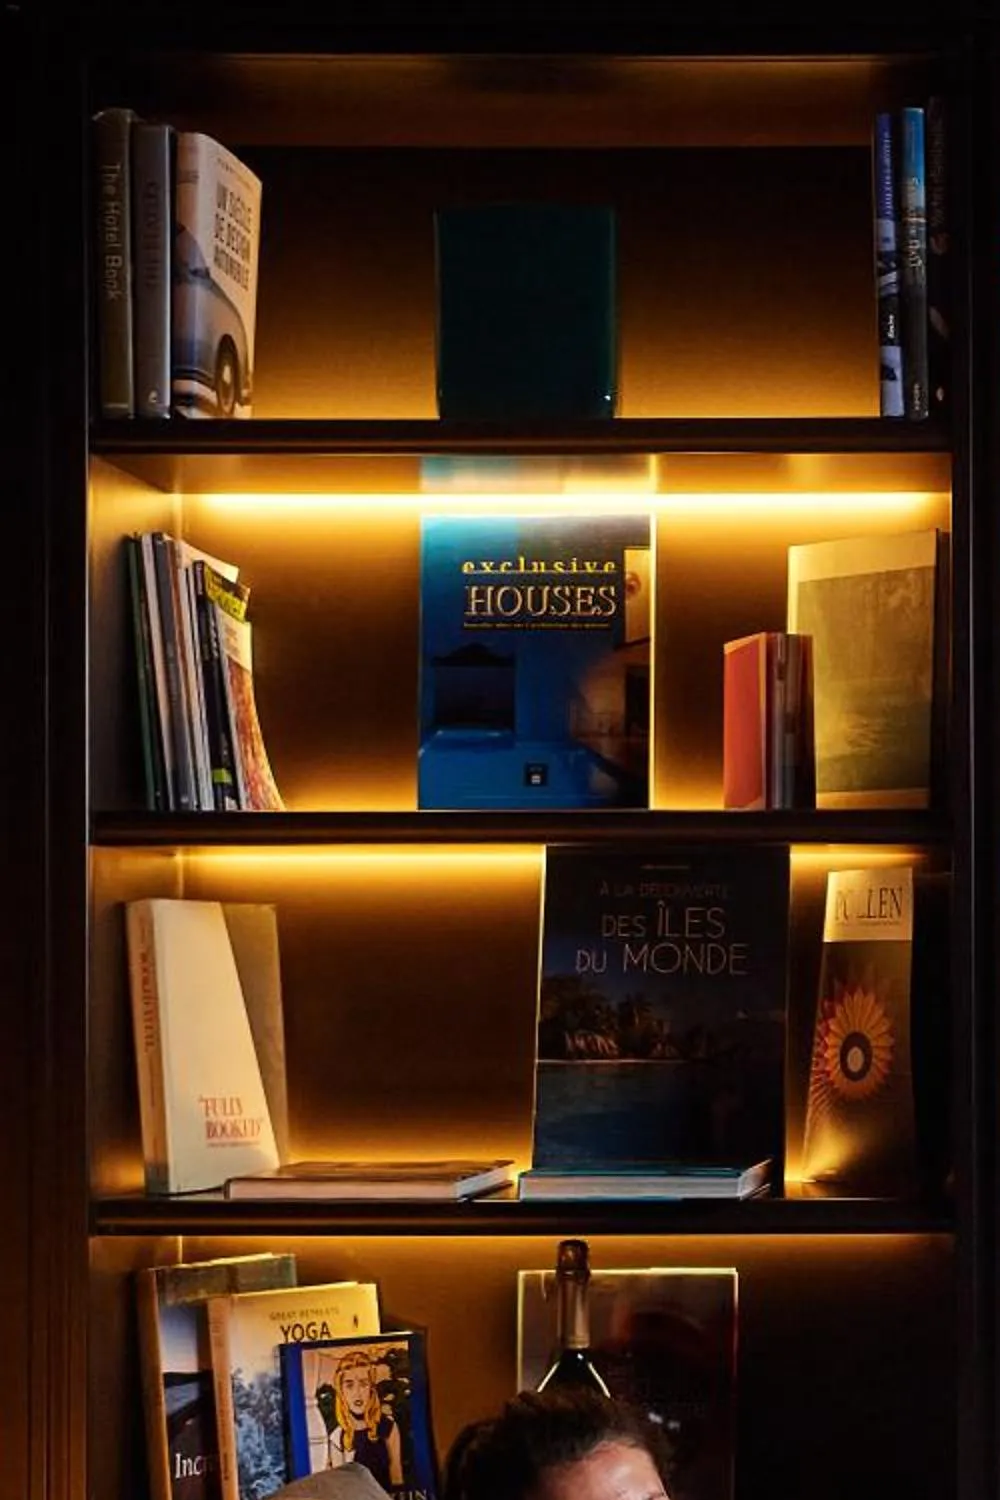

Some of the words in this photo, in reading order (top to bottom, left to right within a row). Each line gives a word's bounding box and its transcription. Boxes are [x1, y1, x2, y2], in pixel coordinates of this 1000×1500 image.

[101, 163, 120, 196] The
[461, 556, 617, 575] exclusive
[463, 585, 617, 617] HOUSES
[602, 914, 647, 939] DES
[656, 899, 727, 939] ÎLES
[575, 949, 608, 974] DU
[622, 941, 751, 976] MONDE
[279, 1321, 332, 1343] YOGA
